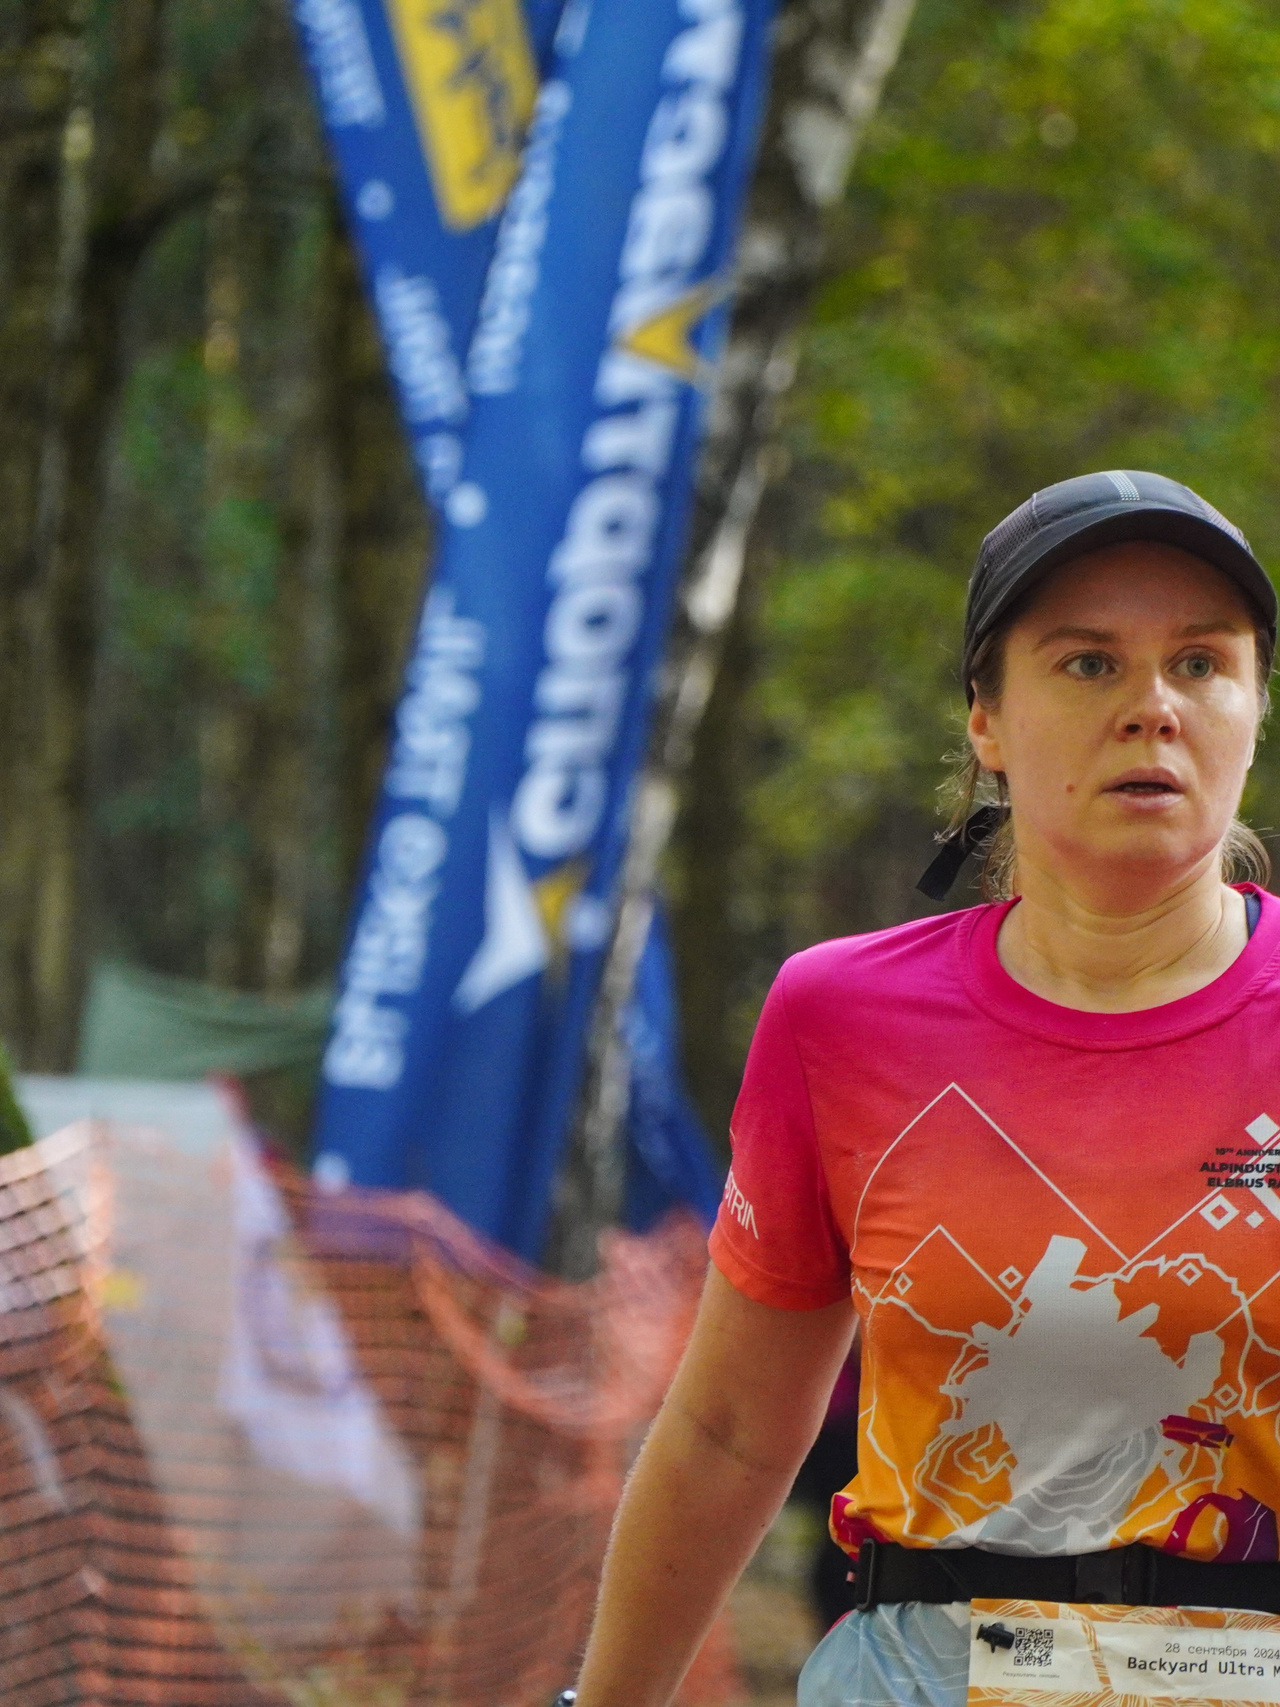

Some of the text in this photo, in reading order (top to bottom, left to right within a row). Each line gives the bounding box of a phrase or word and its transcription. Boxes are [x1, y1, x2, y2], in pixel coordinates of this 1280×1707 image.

[1207, 1177, 1264, 1188] ELBRUS
[1165, 1642, 1280, 1659] 28 сентября 2024
[1127, 1656, 1208, 1675] Backyard
[1218, 1661, 1265, 1677] Ultra
